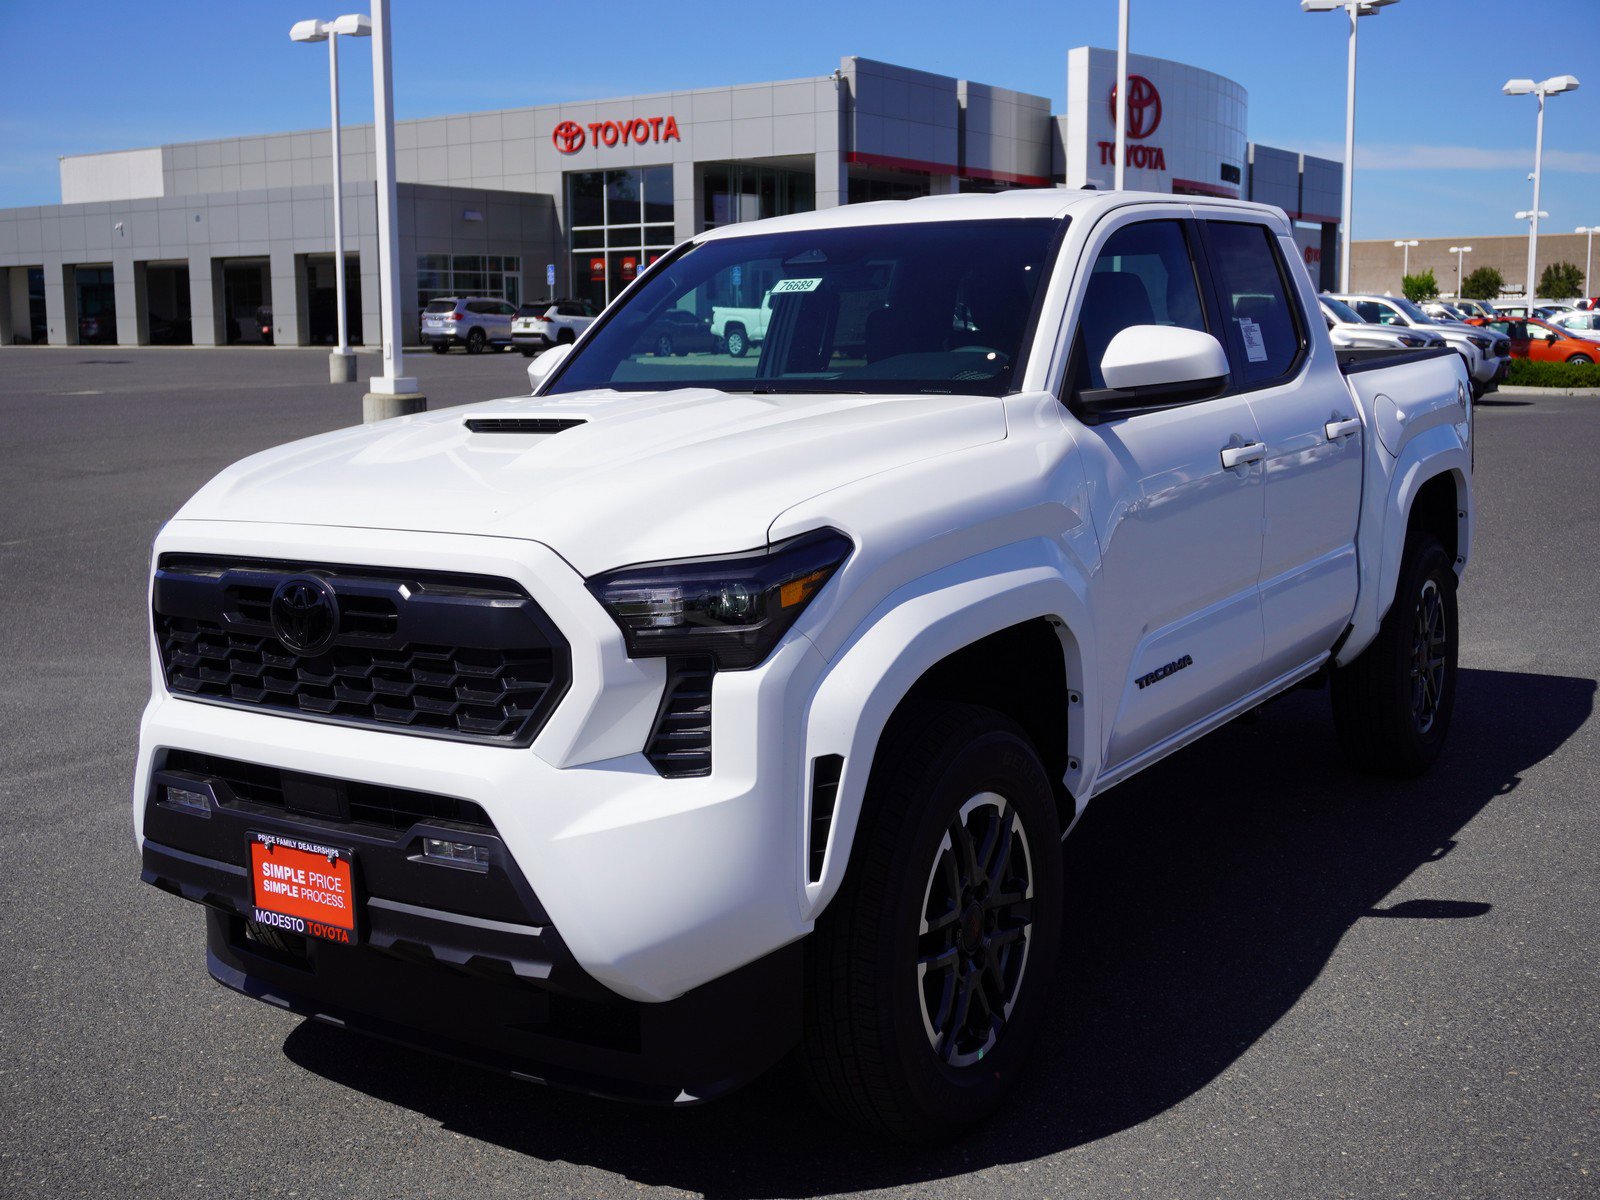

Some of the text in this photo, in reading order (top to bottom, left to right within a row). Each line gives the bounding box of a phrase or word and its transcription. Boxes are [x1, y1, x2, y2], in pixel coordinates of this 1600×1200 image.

[588, 116, 680, 147] TOYOTA
[780, 280, 814, 291] 76689
[1135, 654, 1193, 690] TACOMA
[257, 834, 340, 858] PRICE FAMILY DEALERSHIPS
[262, 862, 345, 893] SIMPLE PRICE.
[263, 879, 346, 909] SIMPLE PROCESS.
[255, 909, 350, 944] MODESTO TOYOTA
